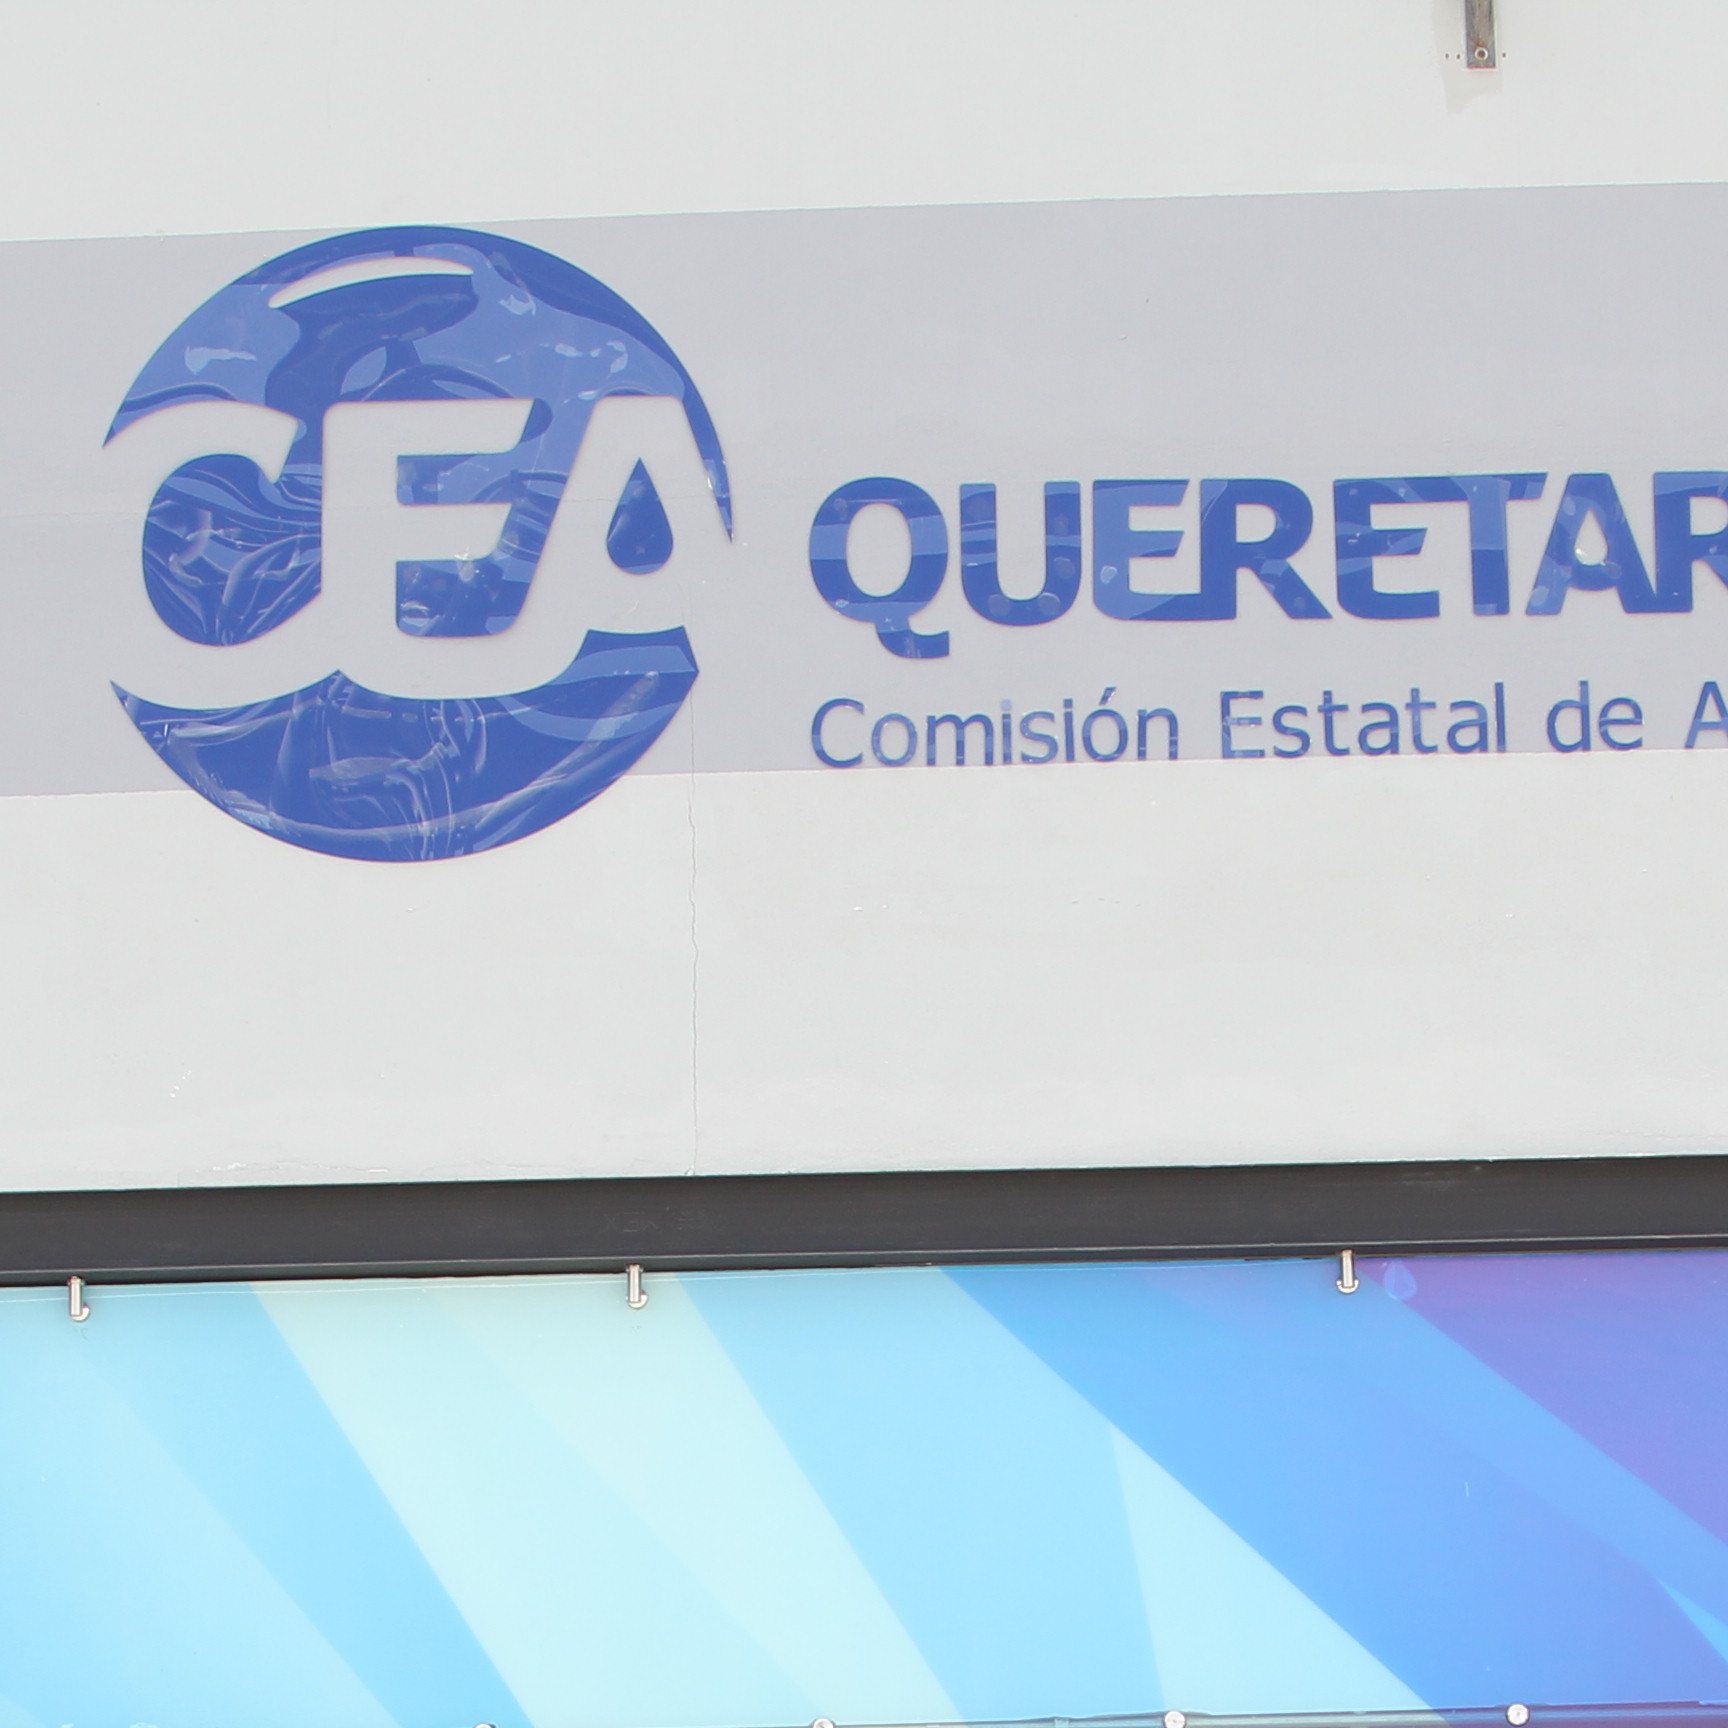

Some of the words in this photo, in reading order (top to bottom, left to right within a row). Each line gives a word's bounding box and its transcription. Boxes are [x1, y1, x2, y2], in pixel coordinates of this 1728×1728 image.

[106, 396, 730, 709] CEA
[811, 686, 1179, 768] Comisión
[1221, 682, 1507, 758] Estatal
[1547, 680, 1643, 753] de
